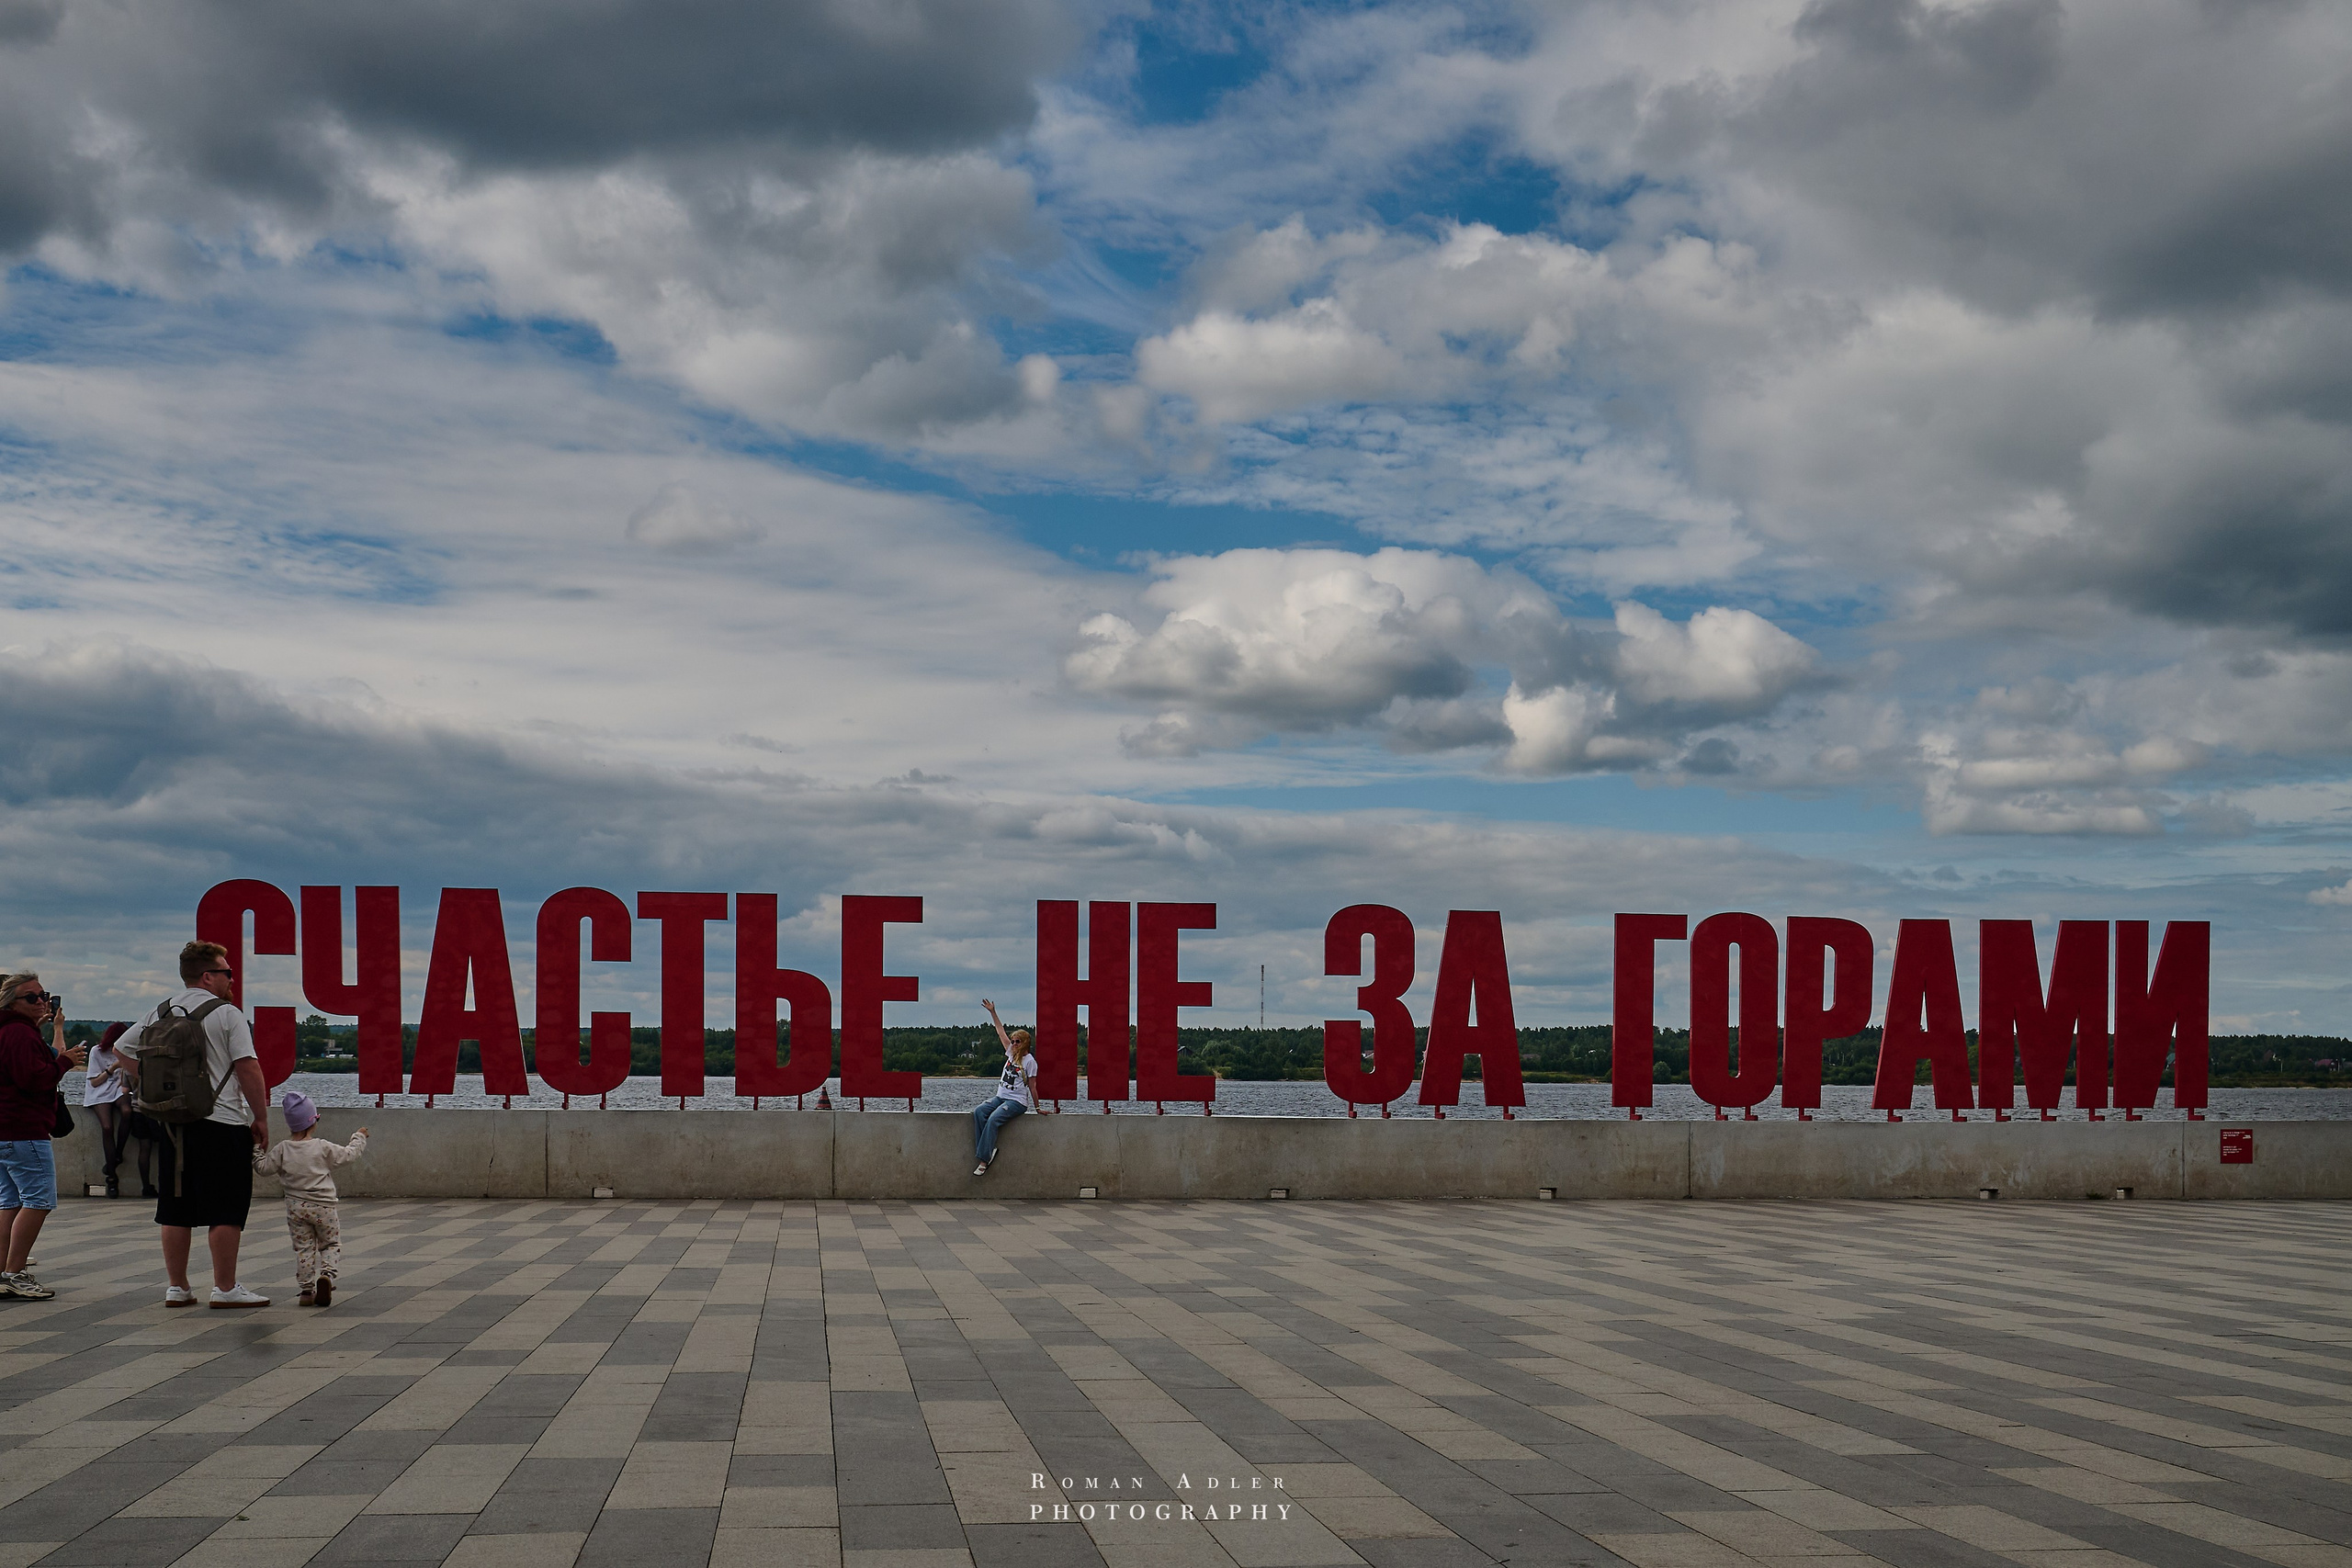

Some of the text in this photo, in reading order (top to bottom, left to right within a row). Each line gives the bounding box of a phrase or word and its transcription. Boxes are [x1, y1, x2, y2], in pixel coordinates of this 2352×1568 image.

[197, 879, 2211, 1111] СЧАСТЬЕ НЕ ЗА ГОРАМИ
